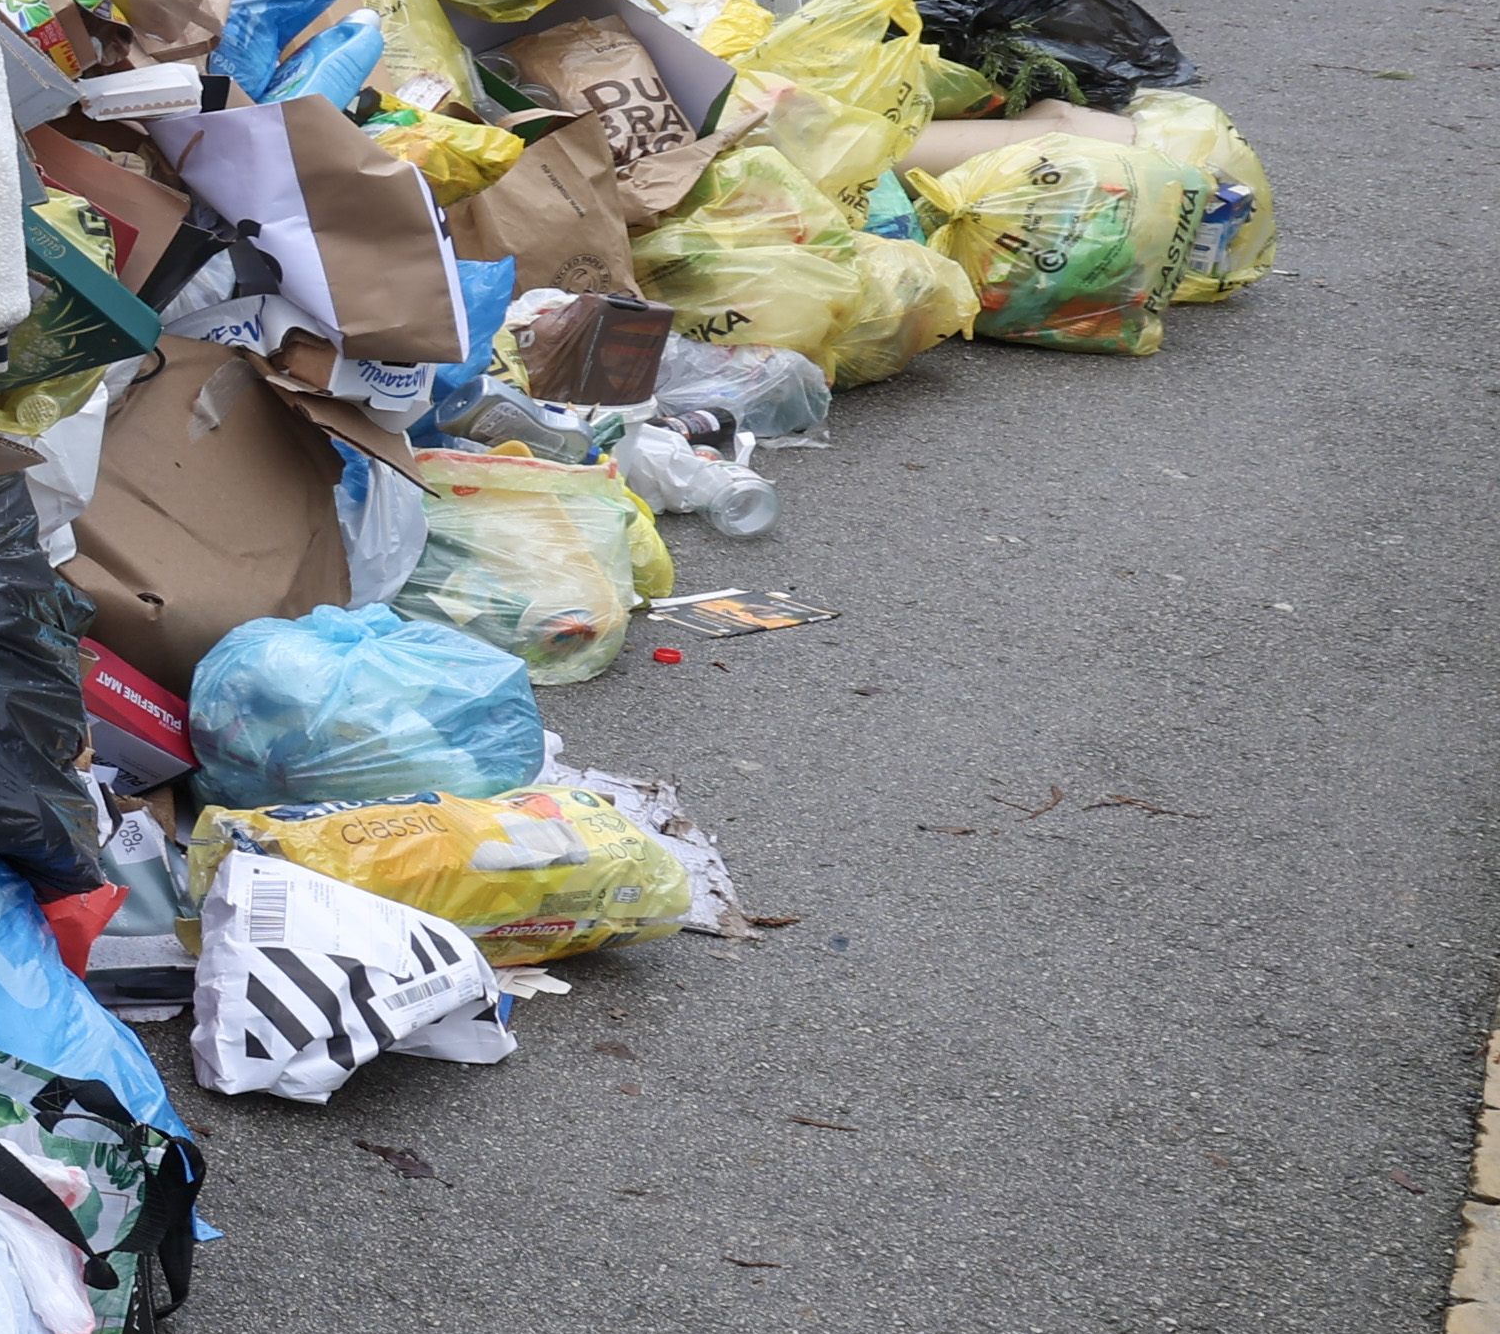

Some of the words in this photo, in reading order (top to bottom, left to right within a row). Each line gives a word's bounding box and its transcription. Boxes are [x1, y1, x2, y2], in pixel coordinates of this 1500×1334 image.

[581, 76, 669, 114] DU
[95, 669, 122, 694] MAT
[121, 682, 183, 732] PULSEFIRE
[339, 810, 450, 847] classic
